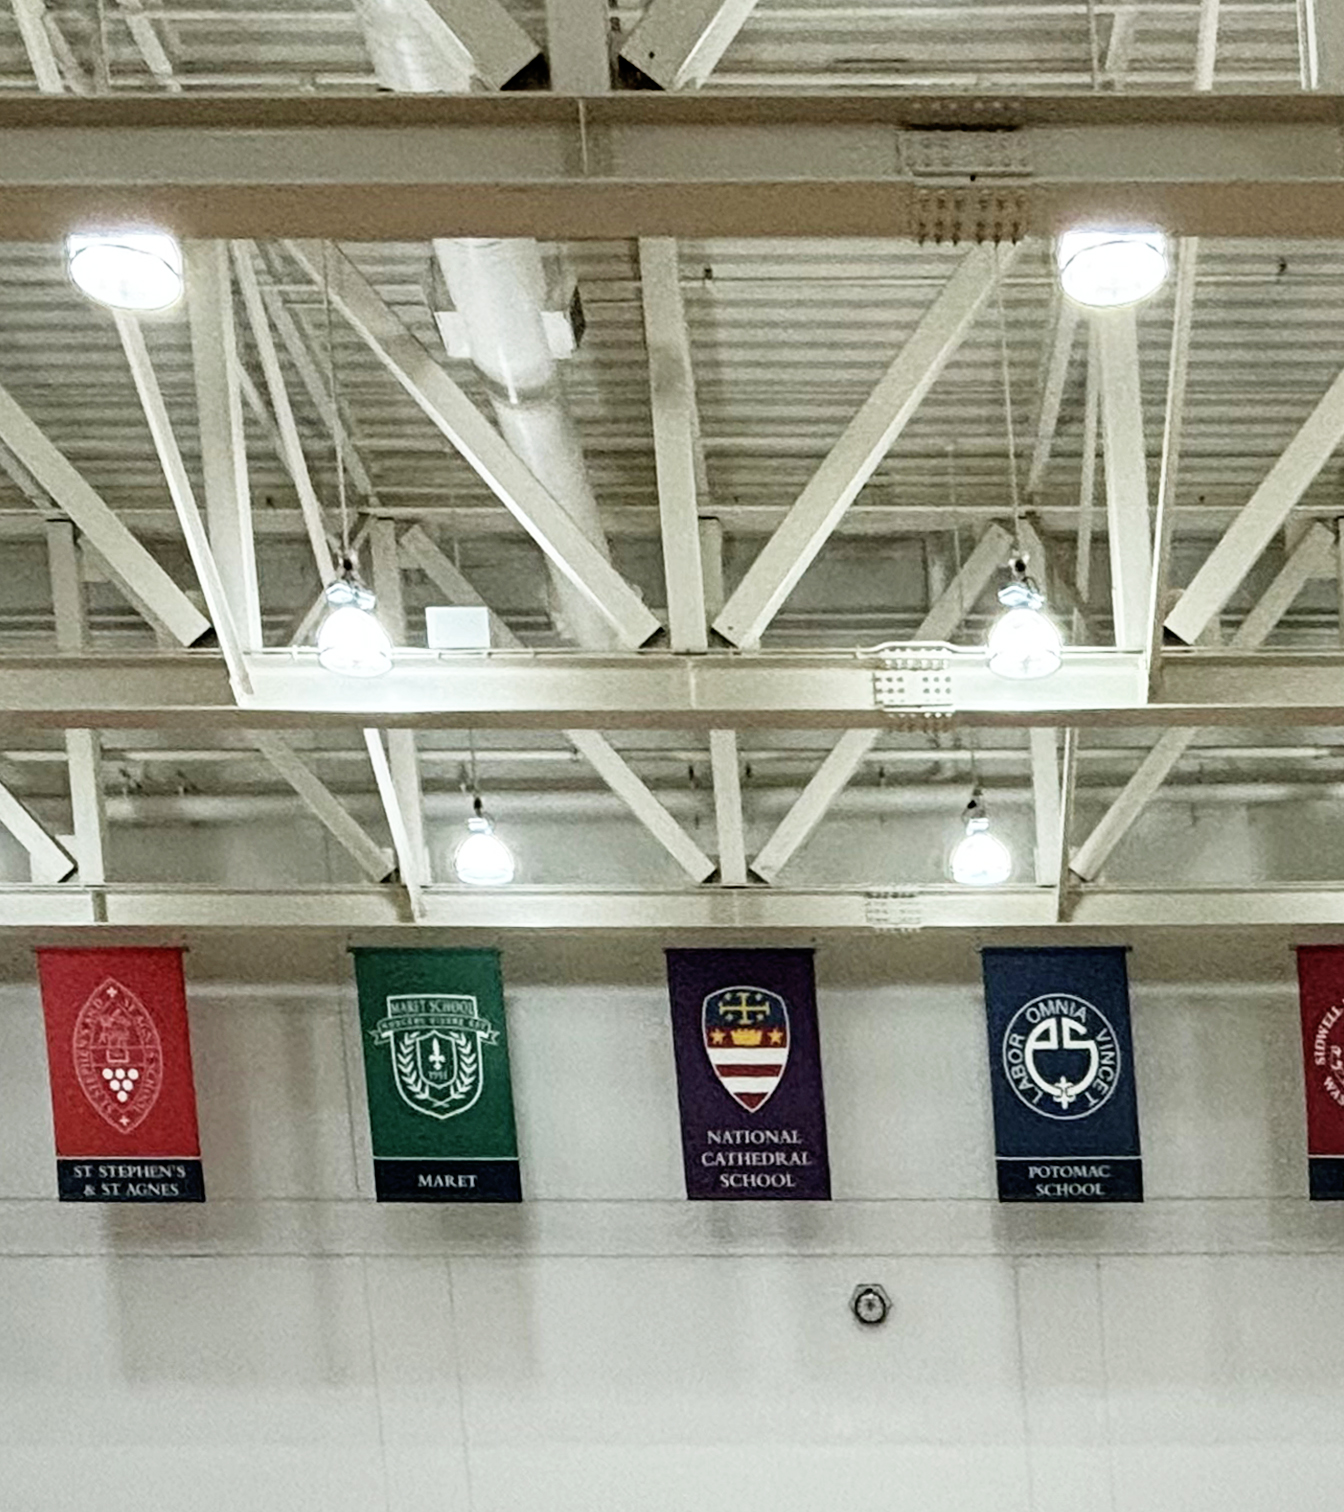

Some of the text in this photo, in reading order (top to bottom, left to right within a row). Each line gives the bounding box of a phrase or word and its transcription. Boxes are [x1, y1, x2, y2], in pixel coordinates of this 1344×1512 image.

[1313, 1005, 1344, 1066] SIDWELL
[1008, 999, 1118, 1107] LABOR OMNIA VINCET
[707, 1129, 803, 1145] NATIONAL
[701, 1152, 812, 1167] CATHEDRAL
[73, 1165, 186, 1179] ST STEPHEN'S
[1028, 1165, 1111, 1179] POTOMAC
[417, 1174, 478, 1188] MARET
[719, 1173, 796, 1188] SCHOOL
[83, 1183, 179, 1196] & ST AGNES
[1035, 1183, 1106, 1196] SCHOOL
